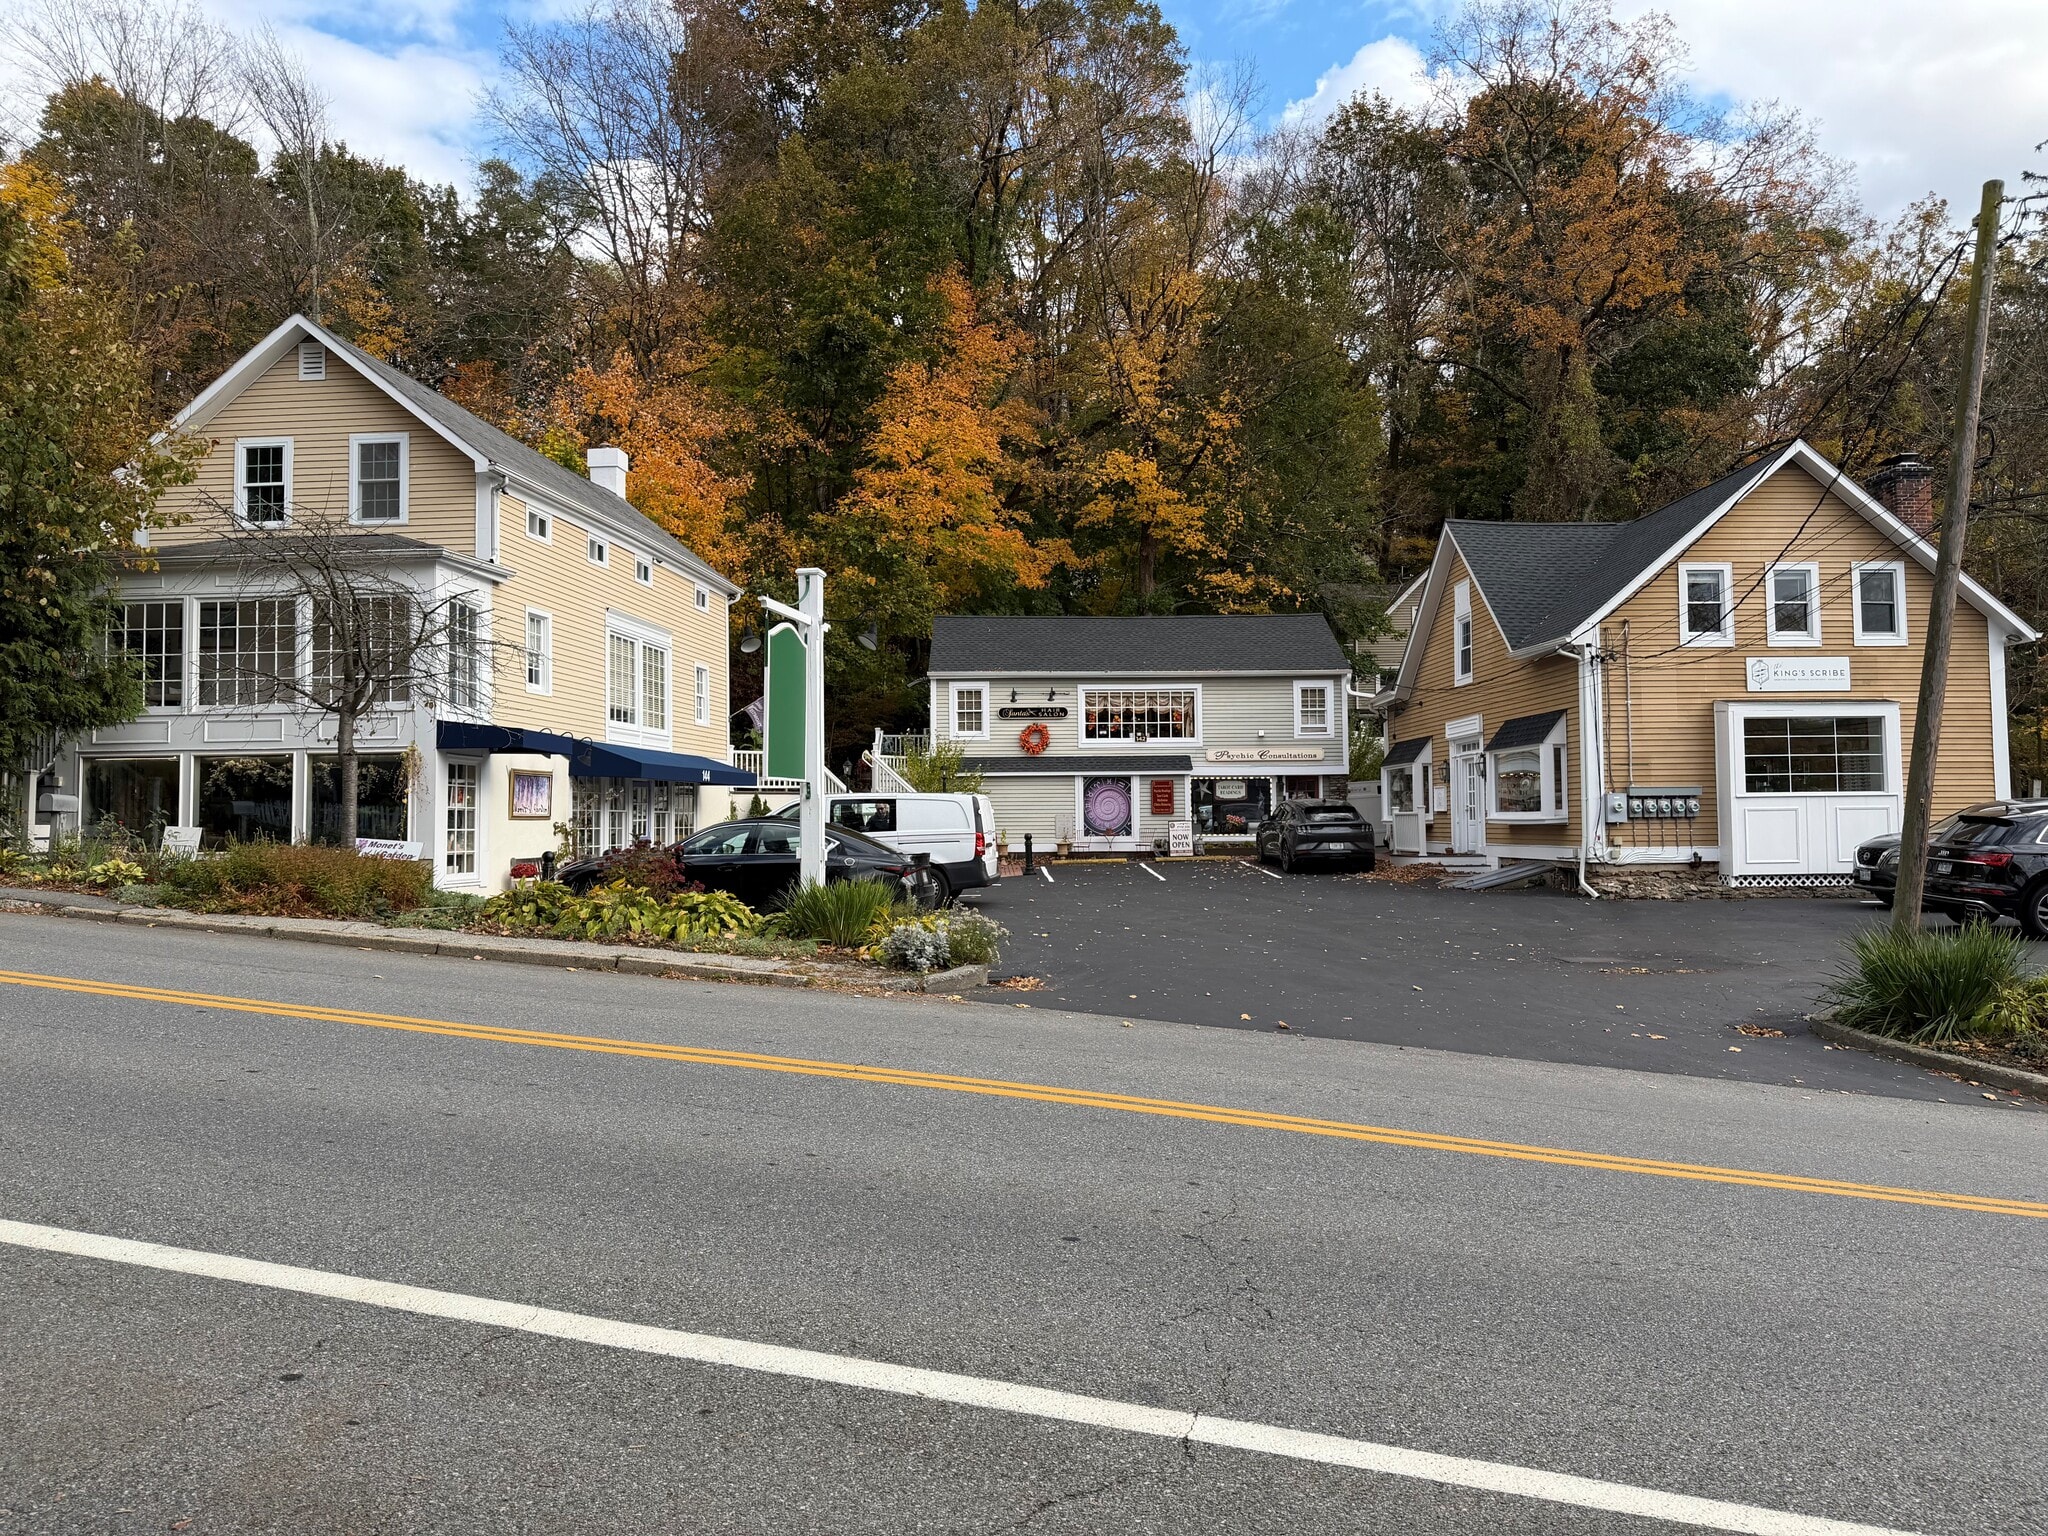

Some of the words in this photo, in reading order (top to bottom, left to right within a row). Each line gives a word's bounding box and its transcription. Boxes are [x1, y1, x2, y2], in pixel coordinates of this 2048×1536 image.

[1773, 669, 1806, 677] KING'S
[1810, 669, 1846, 677] SCRIBE
[1214, 750, 1254, 760] Psychic
[1257, 749, 1317, 760] Consultations
[702, 769, 711, 782] 144
[1172, 833, 1189, 841] NOW
[367, 841, 405, 849] Monet's
[1172, 841, 1190, 849] OPEN
